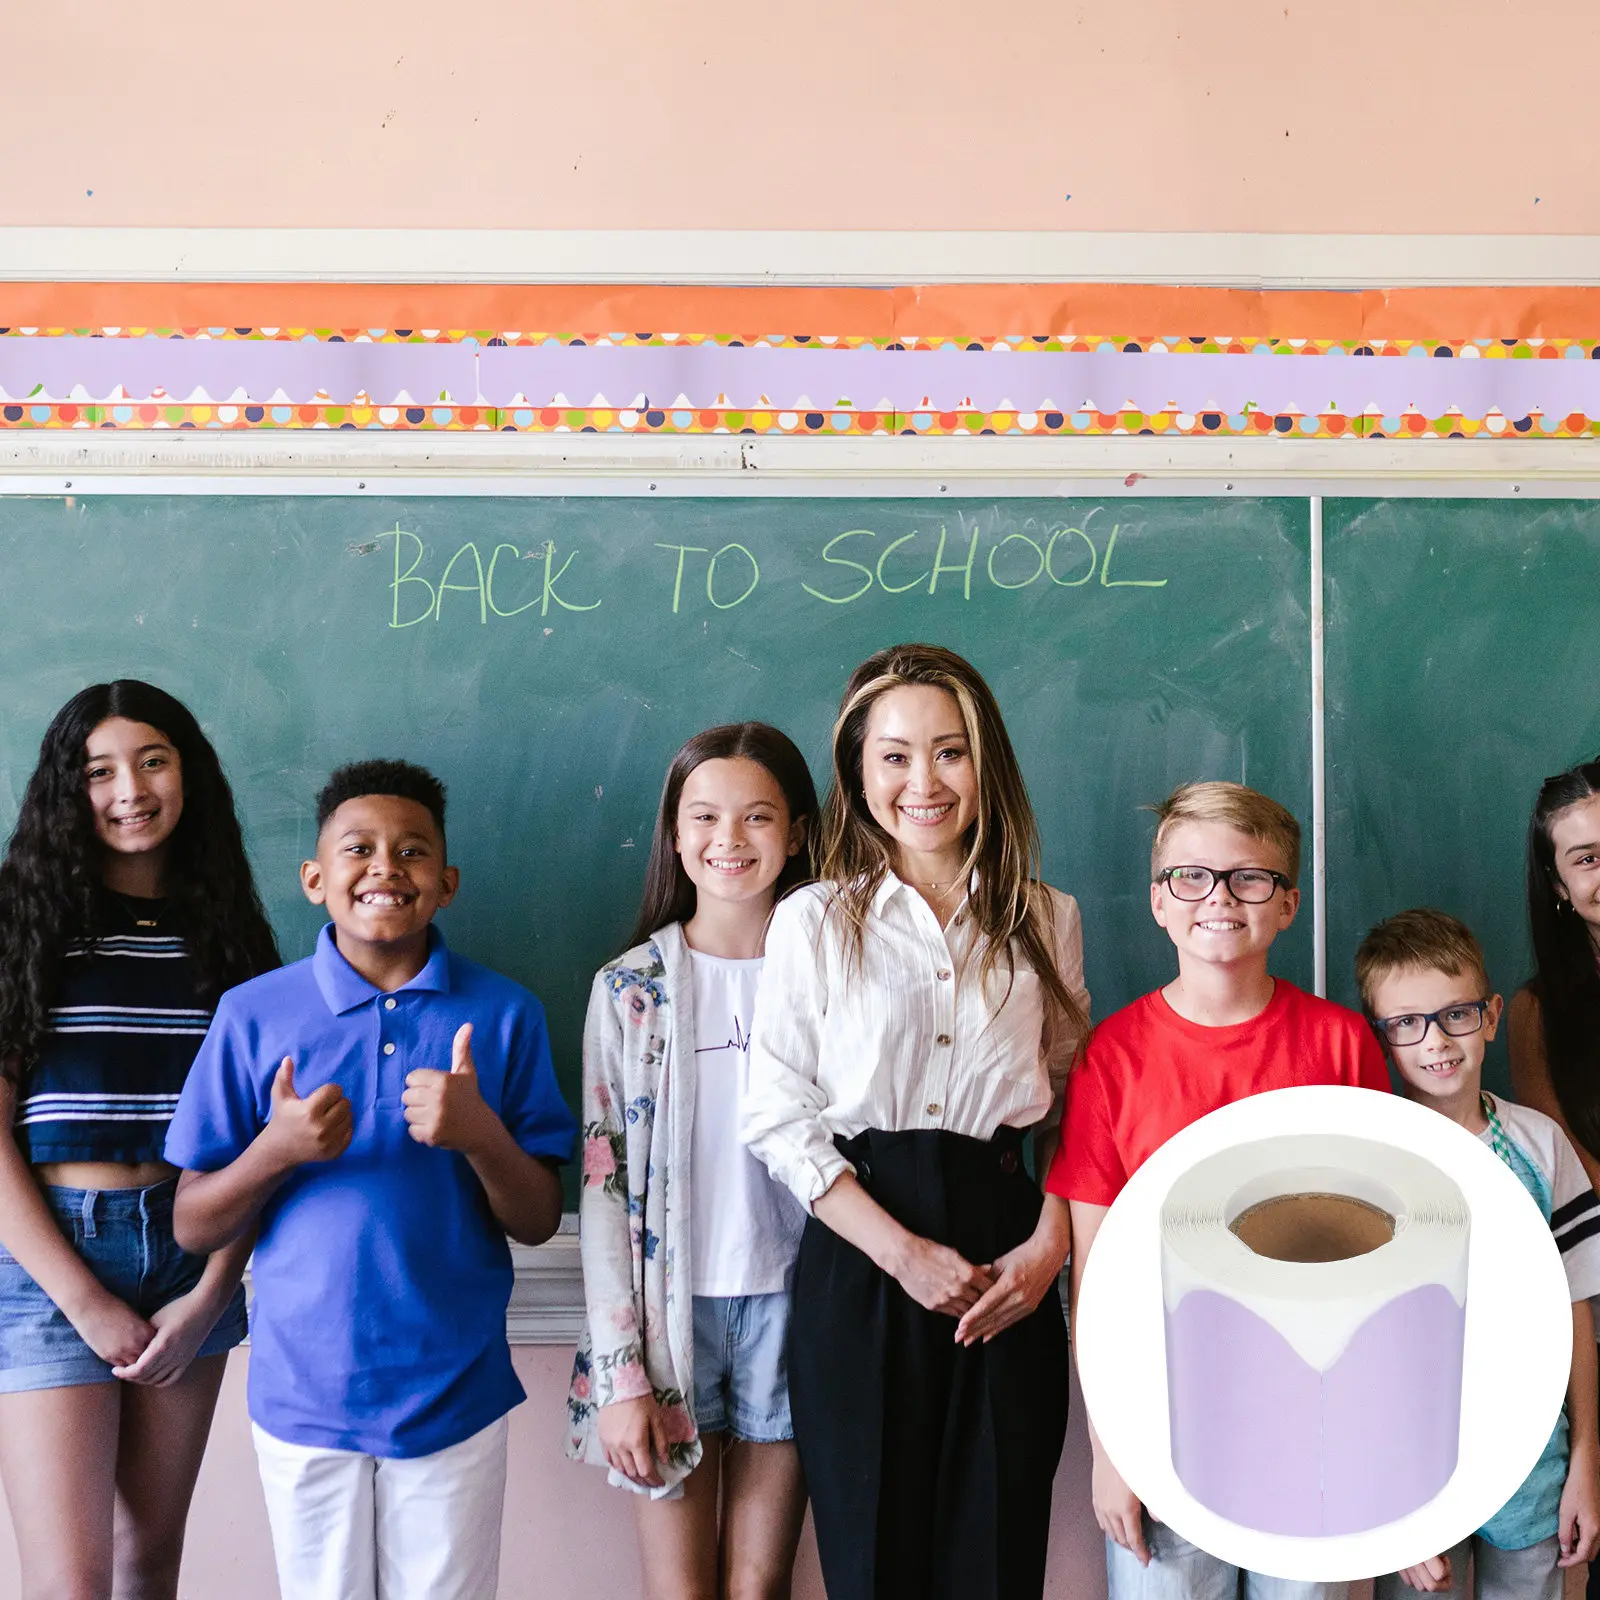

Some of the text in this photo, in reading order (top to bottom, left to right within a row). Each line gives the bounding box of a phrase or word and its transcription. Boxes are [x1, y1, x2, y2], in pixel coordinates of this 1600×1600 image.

[375, 521, 602, 628] BACK
[654, 543, 759, 614] TO
[801, 524, 1168, 604] SCHOOL
